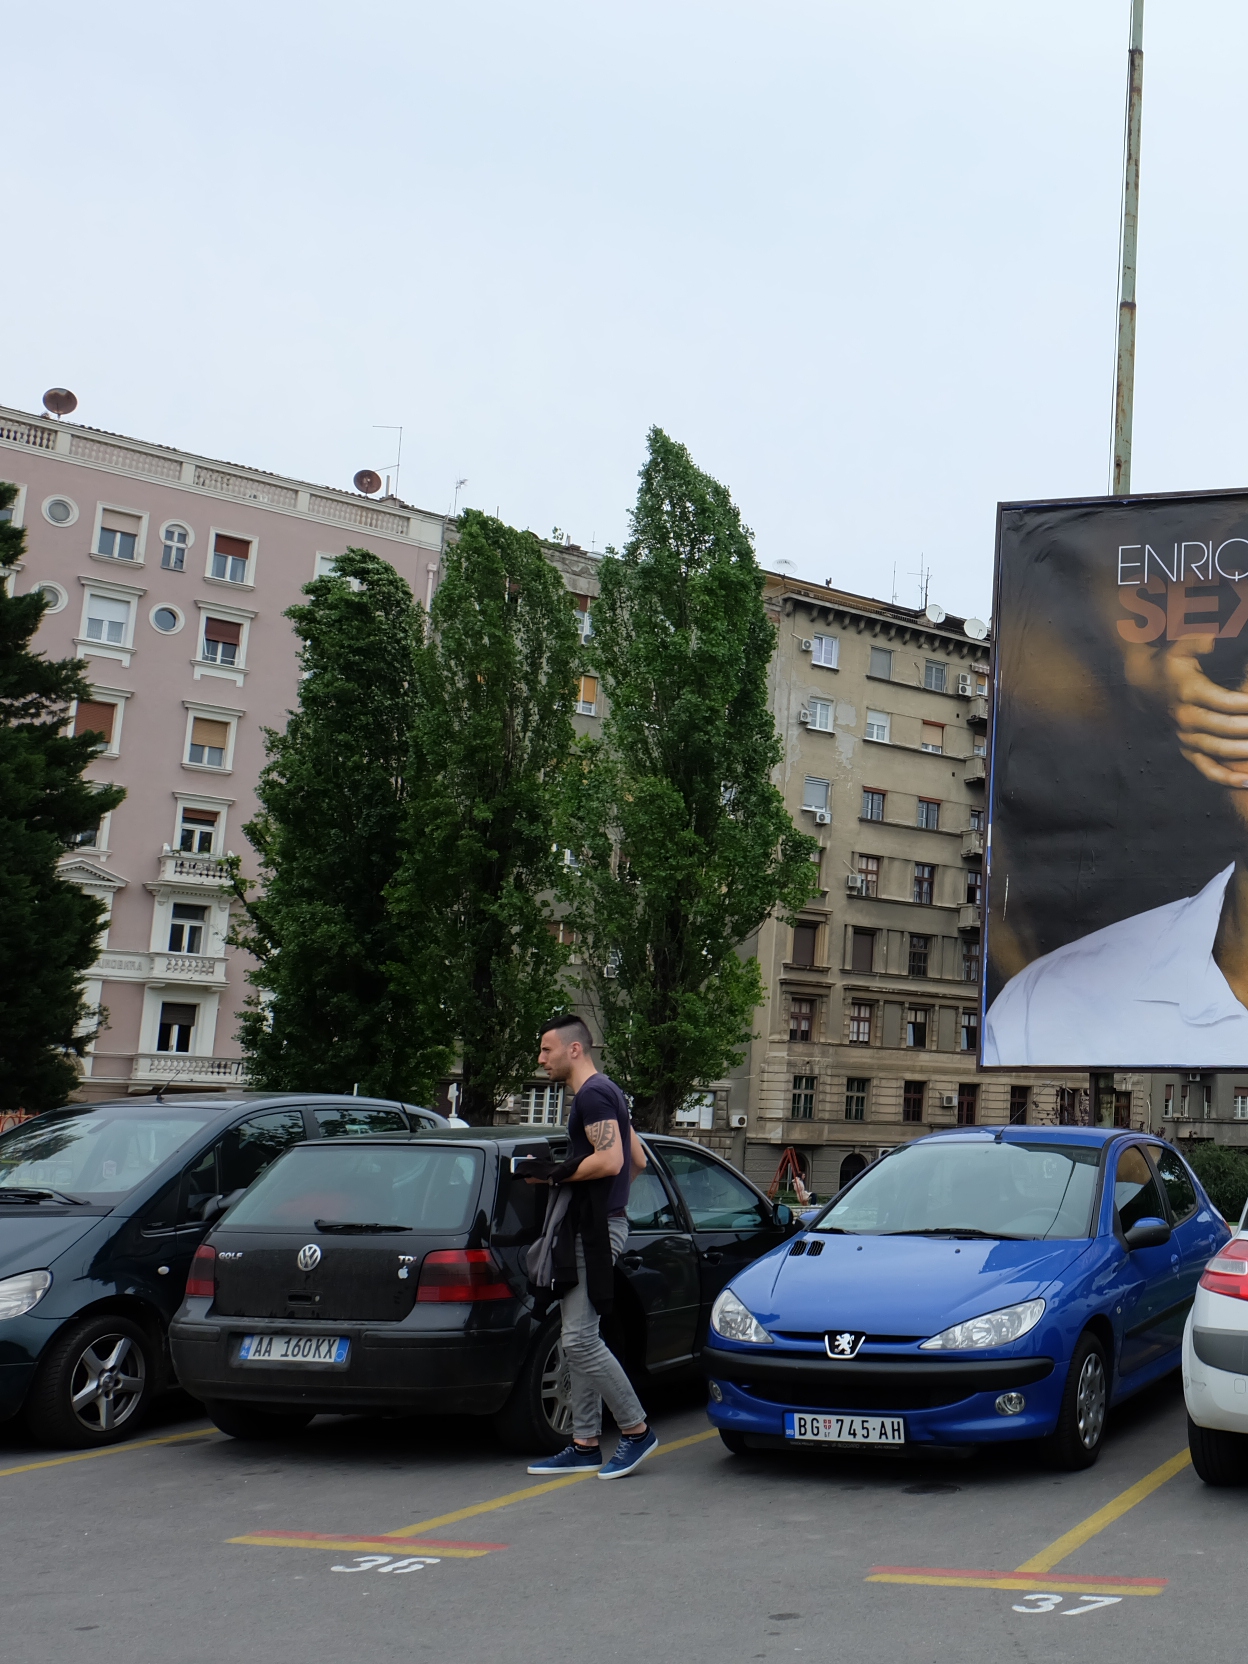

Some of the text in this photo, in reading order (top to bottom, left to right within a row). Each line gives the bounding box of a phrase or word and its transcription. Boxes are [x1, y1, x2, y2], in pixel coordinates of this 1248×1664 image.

[218, 1252, 243, 1260] GOLF
[253, 1337, 338, 1359] AA 160KX
[798, 1417, 820, 1436] BG
[330, 1555, 441, 1574] 36
[1011, 1593, 1123, 1616] 37
